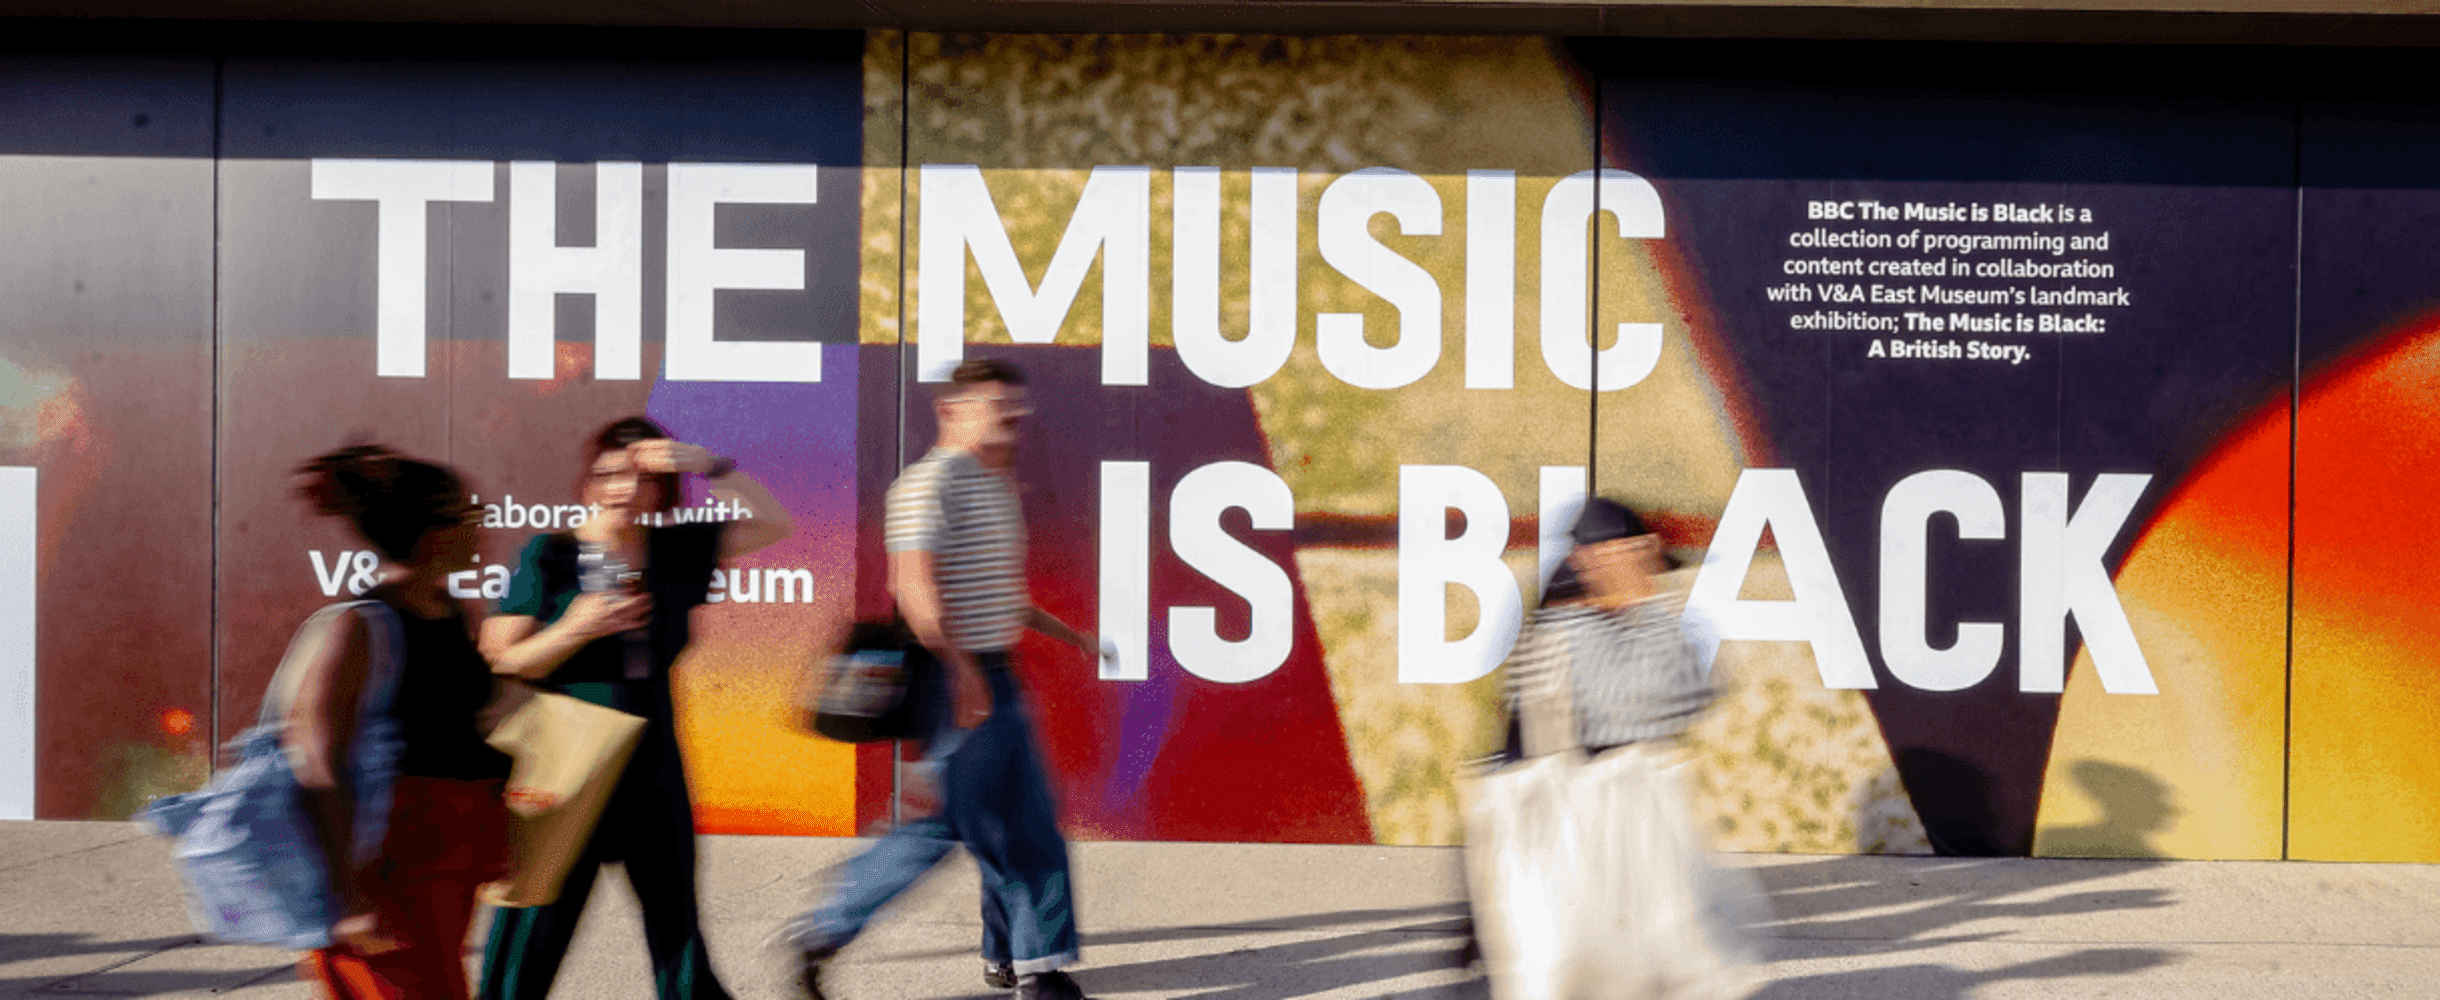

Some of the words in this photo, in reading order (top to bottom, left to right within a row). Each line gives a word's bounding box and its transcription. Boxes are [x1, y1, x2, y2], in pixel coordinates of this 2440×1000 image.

[1807, 200, 1855, 221] BBC
[1858, 200, 1900, 221] The
[1903, 201, 1968, 222] Music
[1970, 202, 1989, 222] is
[1992, 202, 2054, 224] Black
[2058, 203, 2075, 224] is
[2078, 207, 2093, 224] a
[1789, 227, 1892, 248] collection
[1896, 228, 1921, 249] of
[1923, 230, 2065, 256] programming
[2069, 230, 2109, 251] and
[311, 158, 822, 382] THE
[917, 164, 1666, 391] MUSIC
[1783, 256, 1864, 276] content
[1868, 256, 1947, 277] created
[1951, 257, 1971, 277] in
[1975, 257, 2115, 279] collaboration
[1766, 282, 1812, 302] with
[1817, 283, 1866, 303] V&A
[1870, 283, 1916, 304] East
[2030, 285, 2131, 306] landmark
[1789, 309, 1900, 334] exhibition;
[1903, 311, 1946, 332] The
[1948, 312, 2013, 333] Music
[2015, 312, 2035, 333] is
[2038, 312, 2106, 333] Black:
[1867, 338, 1886, 358] A
[1890, 338, 1963, 359] British
[1966, 340, 2031, 365] Story.
[308, 549, 380, 597] V&
[1099, 460, 1294, 684] IS
